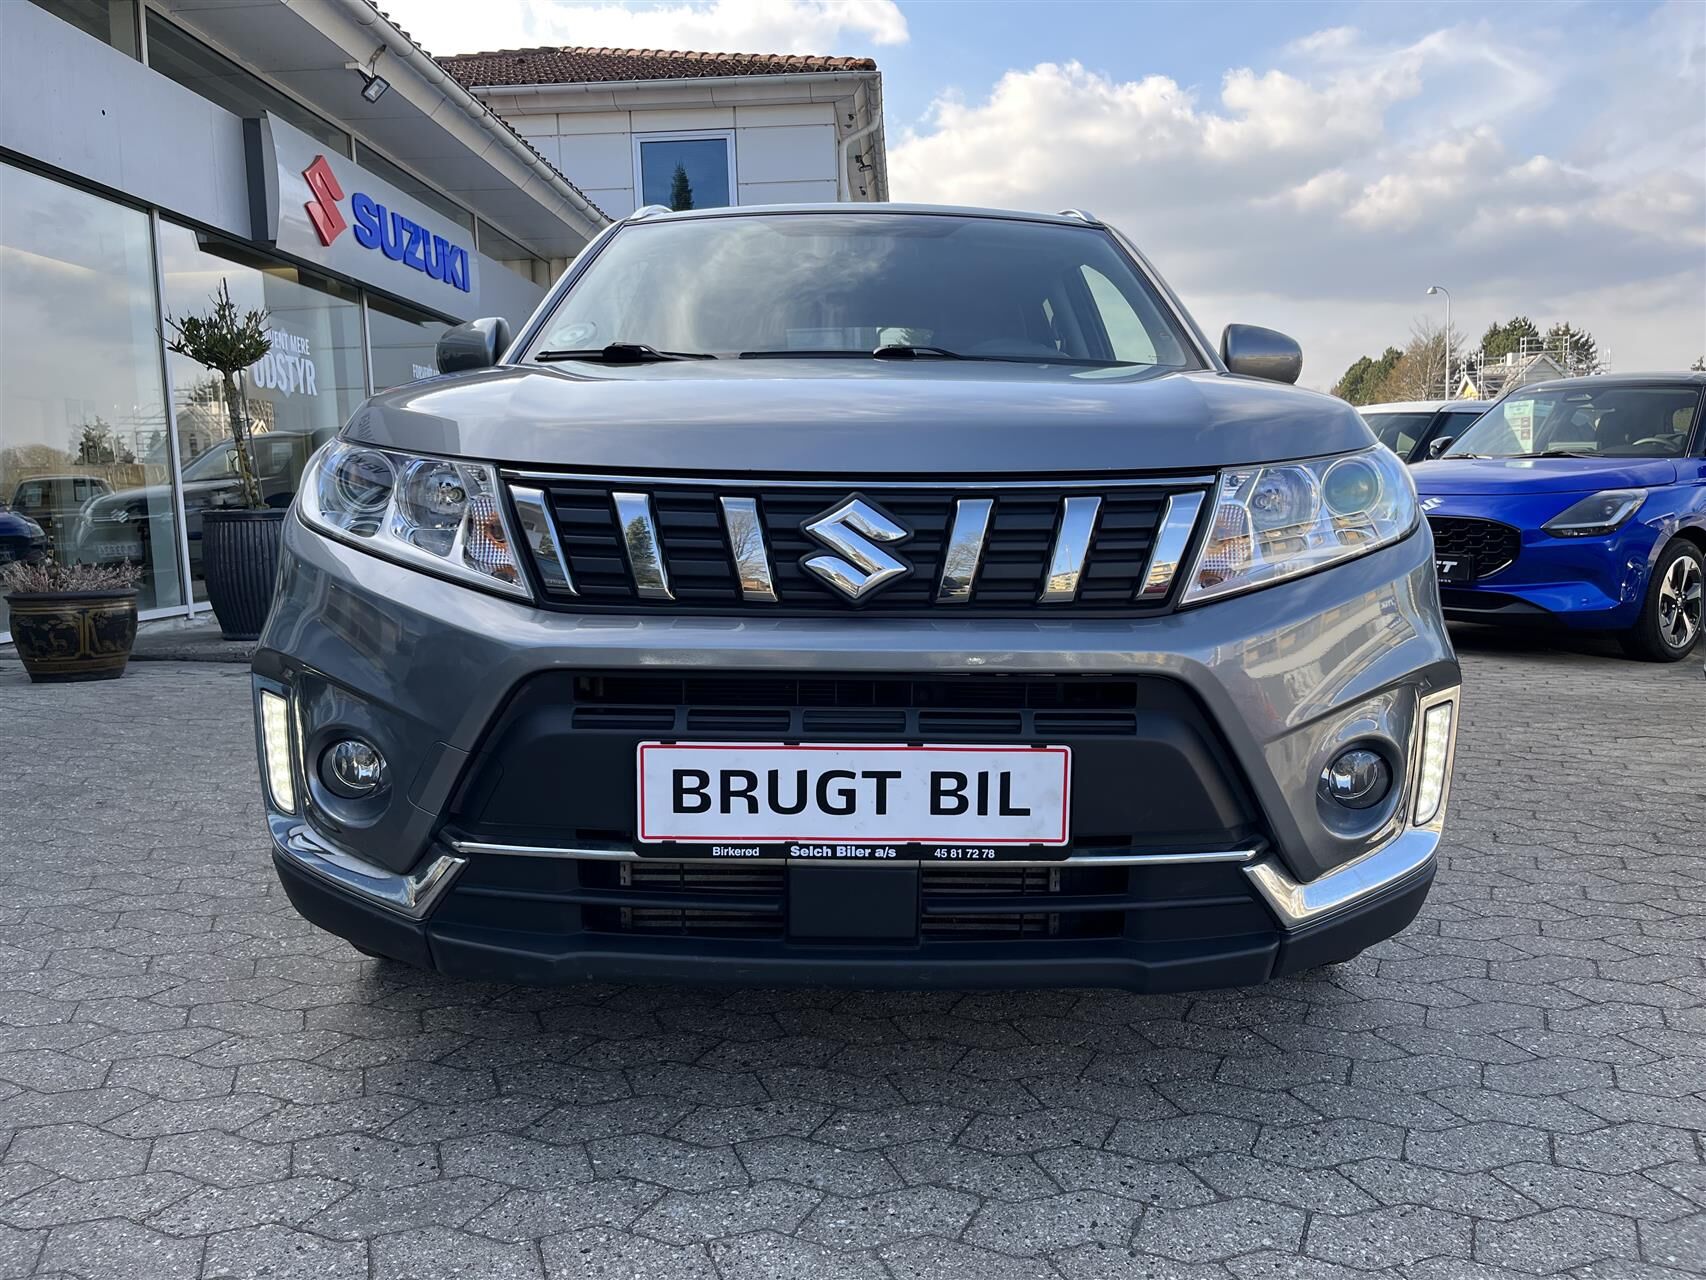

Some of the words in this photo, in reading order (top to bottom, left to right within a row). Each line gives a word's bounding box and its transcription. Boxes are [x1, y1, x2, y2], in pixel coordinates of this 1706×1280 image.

[352, 192, 471, 293] SUZUKI
[290, 335, 310, 355] MERE
[254, 352, 318, 396] UDSTYR
[672, 768, 902, 816] BRUGT
[929, 770, 1031, 817] BIL
[712, 846, 760, 857] Birkerød
[790, 846, 832, 858] Selch
[836, 846, 871, 858] Biler
[874, 846, 897, 859] a/s
[934, 848, 948, 859] 45
[950, 848, 963, 859] 81
[966, 848, 979, 859] 72
[981, 848, 996, 859] 78
